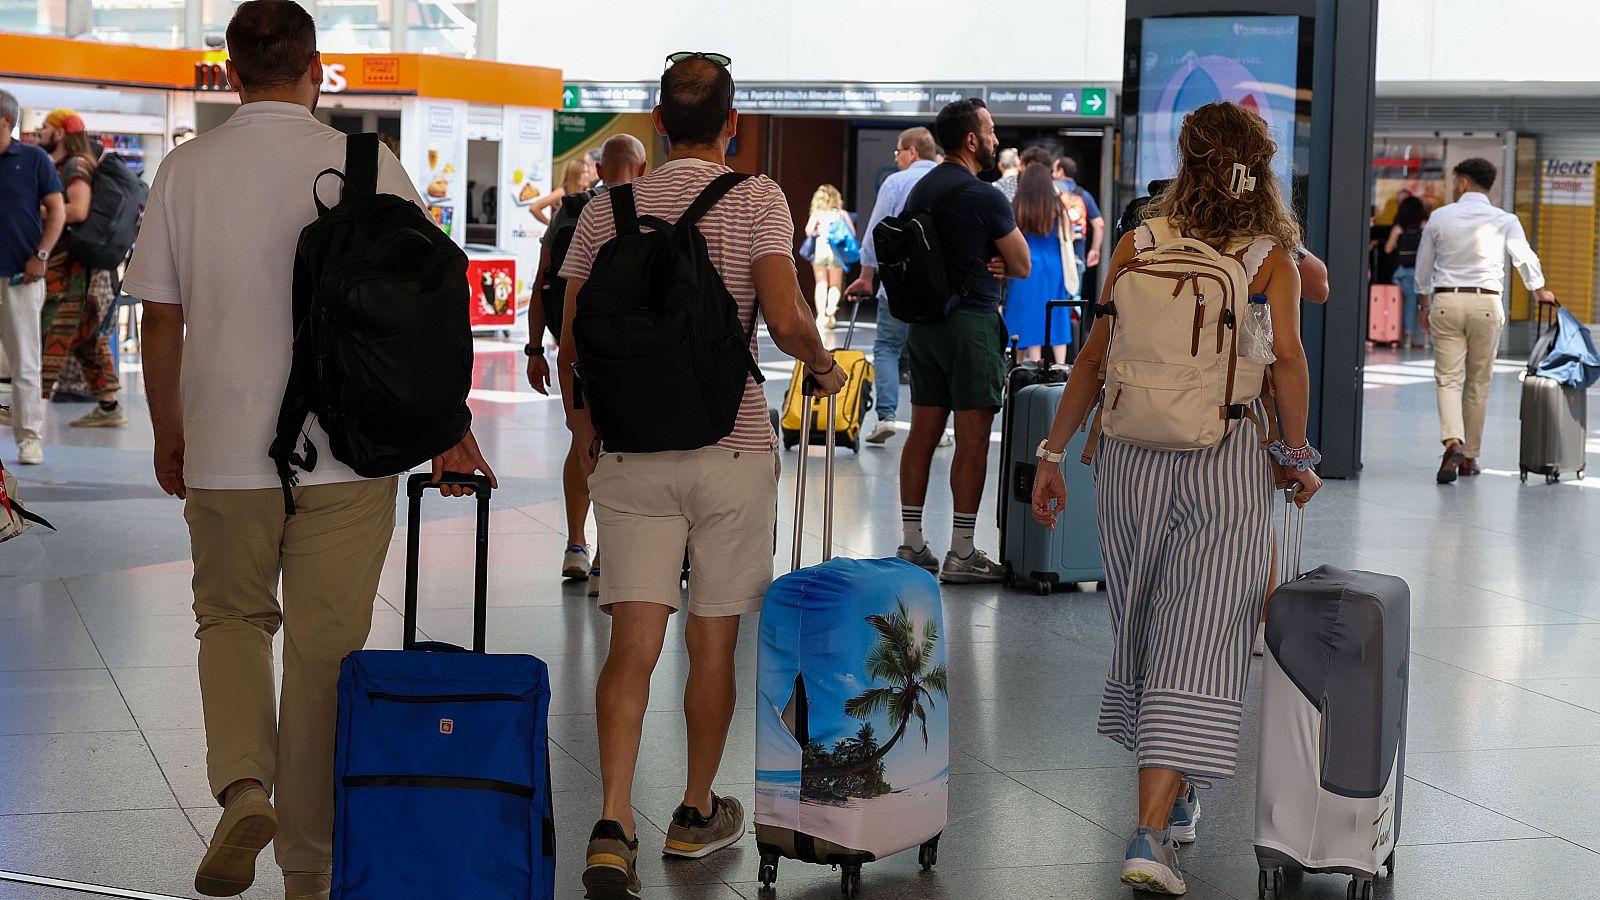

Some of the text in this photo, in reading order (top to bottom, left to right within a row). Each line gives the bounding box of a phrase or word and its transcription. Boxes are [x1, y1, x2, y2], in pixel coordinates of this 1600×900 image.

[989, 91, 1052, 102] Alquiler de coches
[1546, 159, 1592, 175] Hertz
